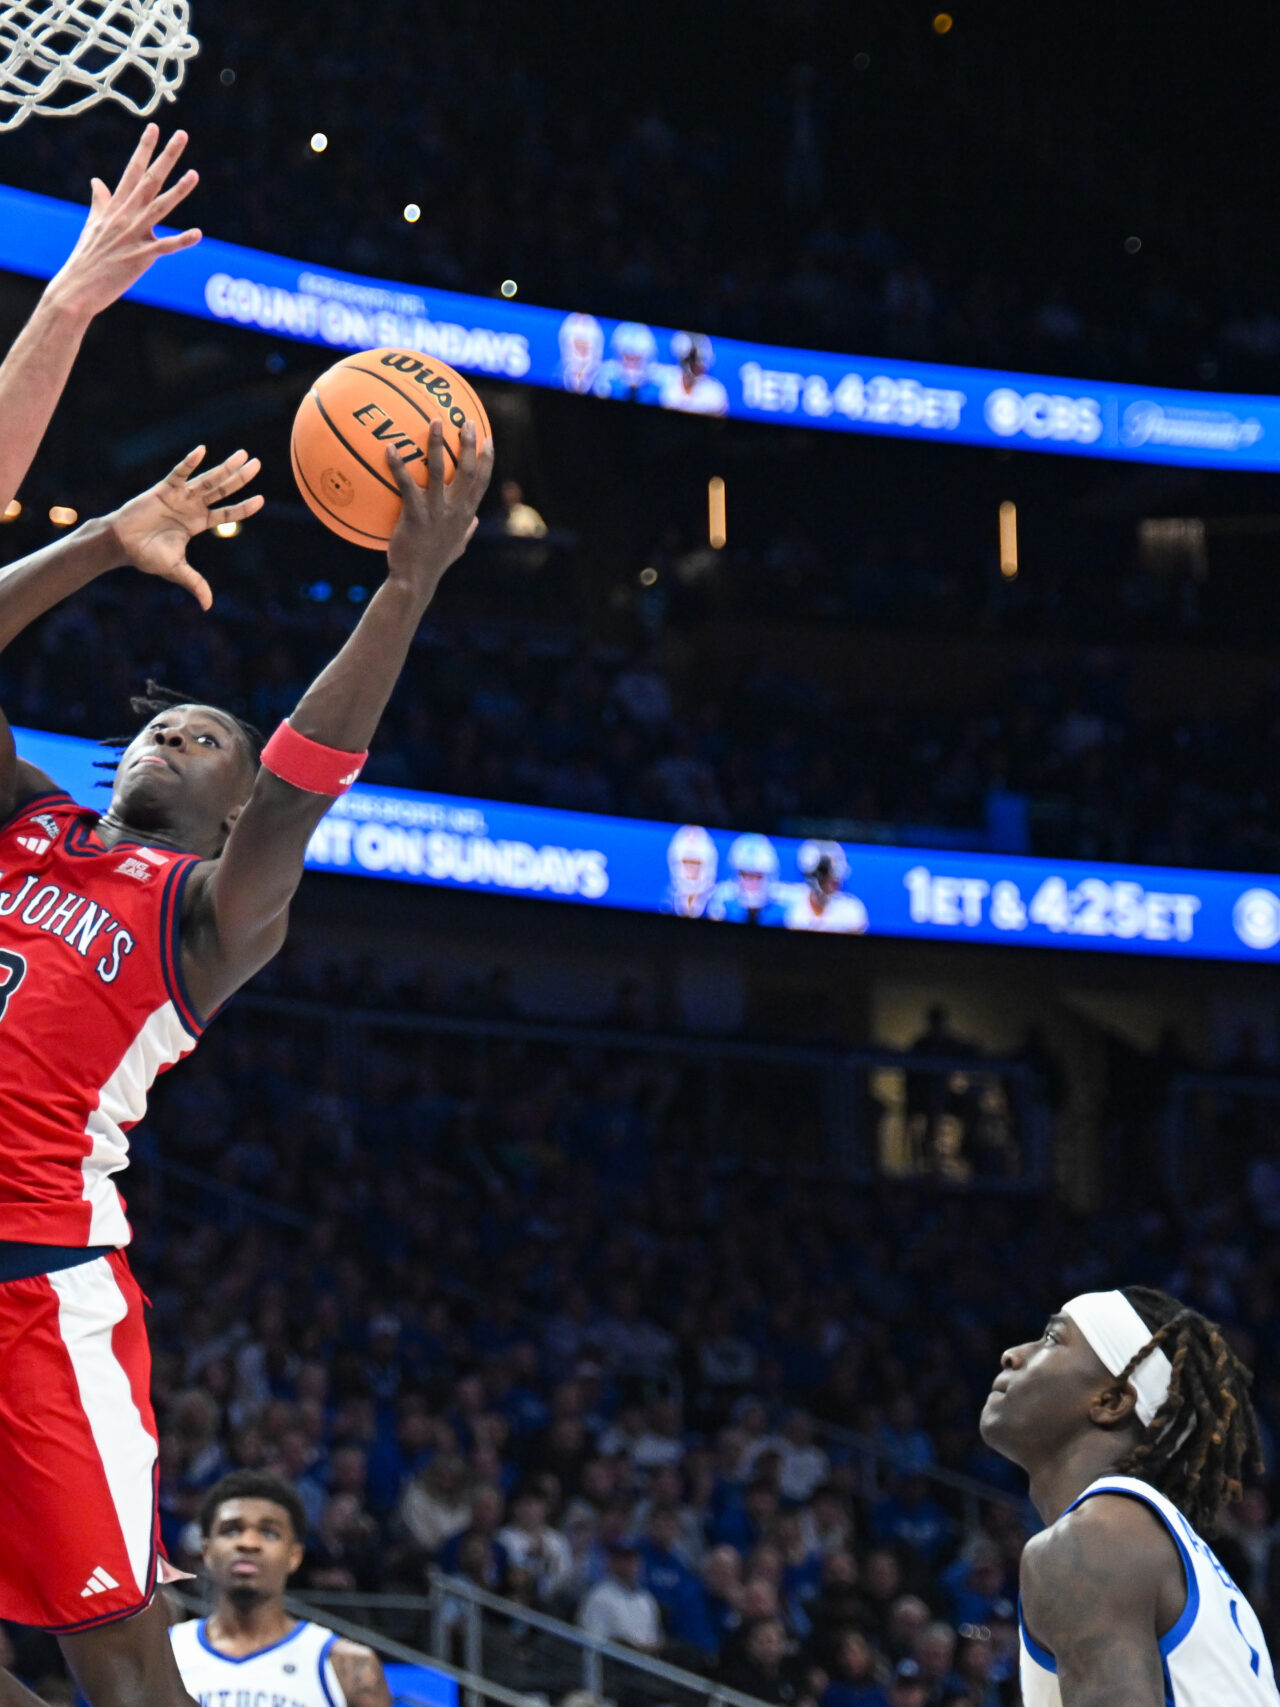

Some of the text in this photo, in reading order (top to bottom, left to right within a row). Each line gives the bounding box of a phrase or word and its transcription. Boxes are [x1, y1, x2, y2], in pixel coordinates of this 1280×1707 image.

[205, 273, 321, 338] COUNT
[320, 300, 374, 349] ON
[373, 311, 531, 377] SUNDAYS
[380, 352, 468, 430] Wilso
[801, 374, 835, 418] &
[1021, 392, 1104, 444] CBS
[353, 822, 426, 876] ON
[423, 831, 609, 898] SUNDAYS
[989, 880, 1029, 931] &
